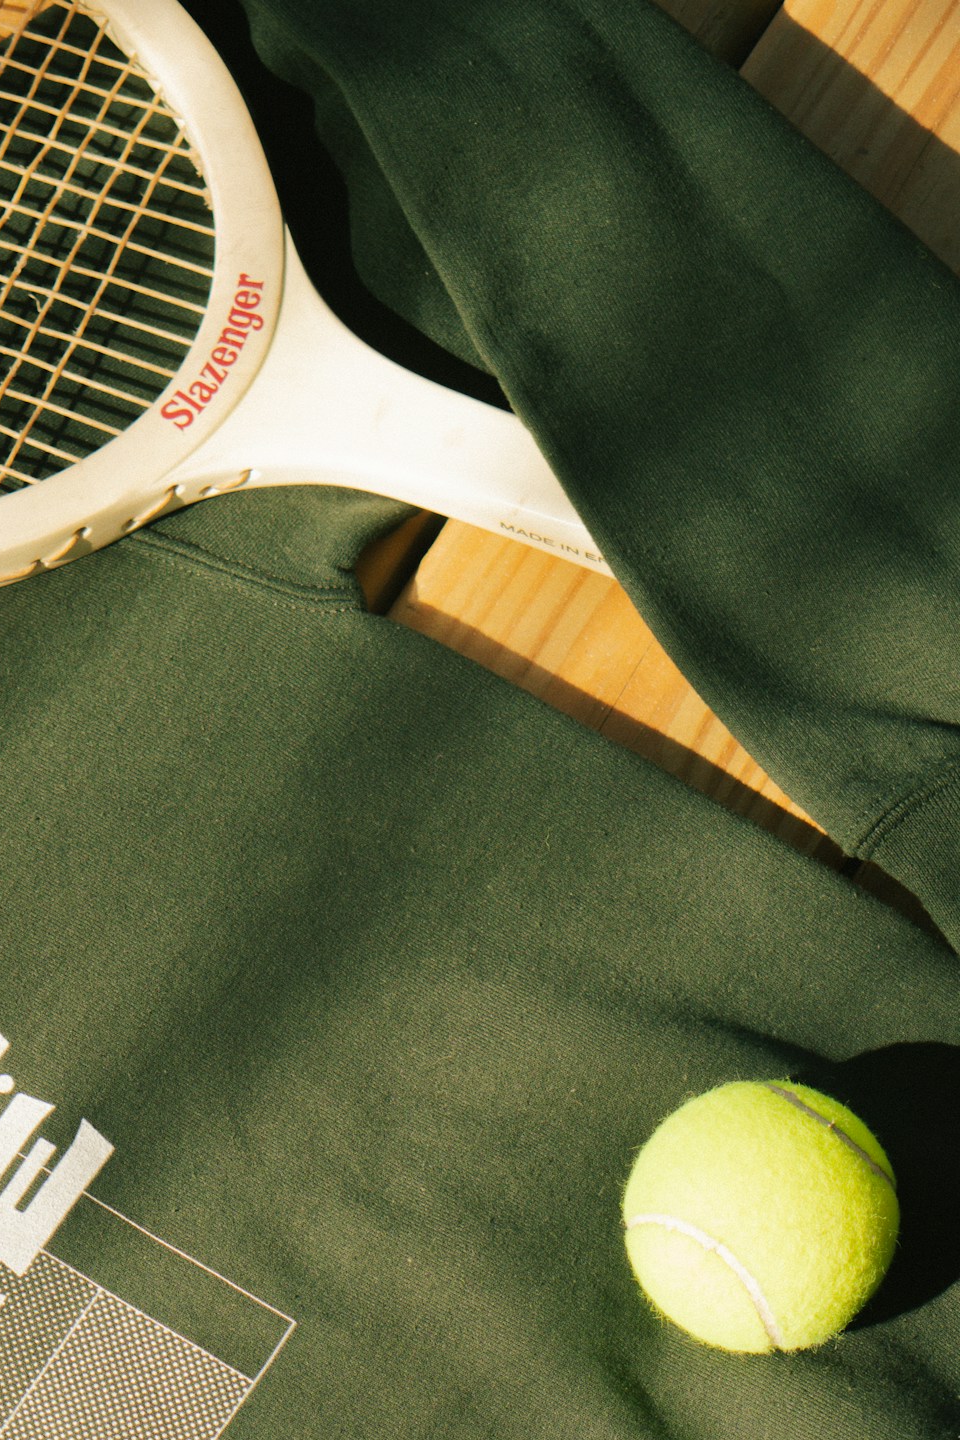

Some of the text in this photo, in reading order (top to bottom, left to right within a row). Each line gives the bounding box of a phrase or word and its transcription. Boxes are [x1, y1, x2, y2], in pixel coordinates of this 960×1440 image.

[160, 272, 265, 431] Slazenger
[500, 522, 556, 548] MADE
[560, 543, 580, 556] IN
